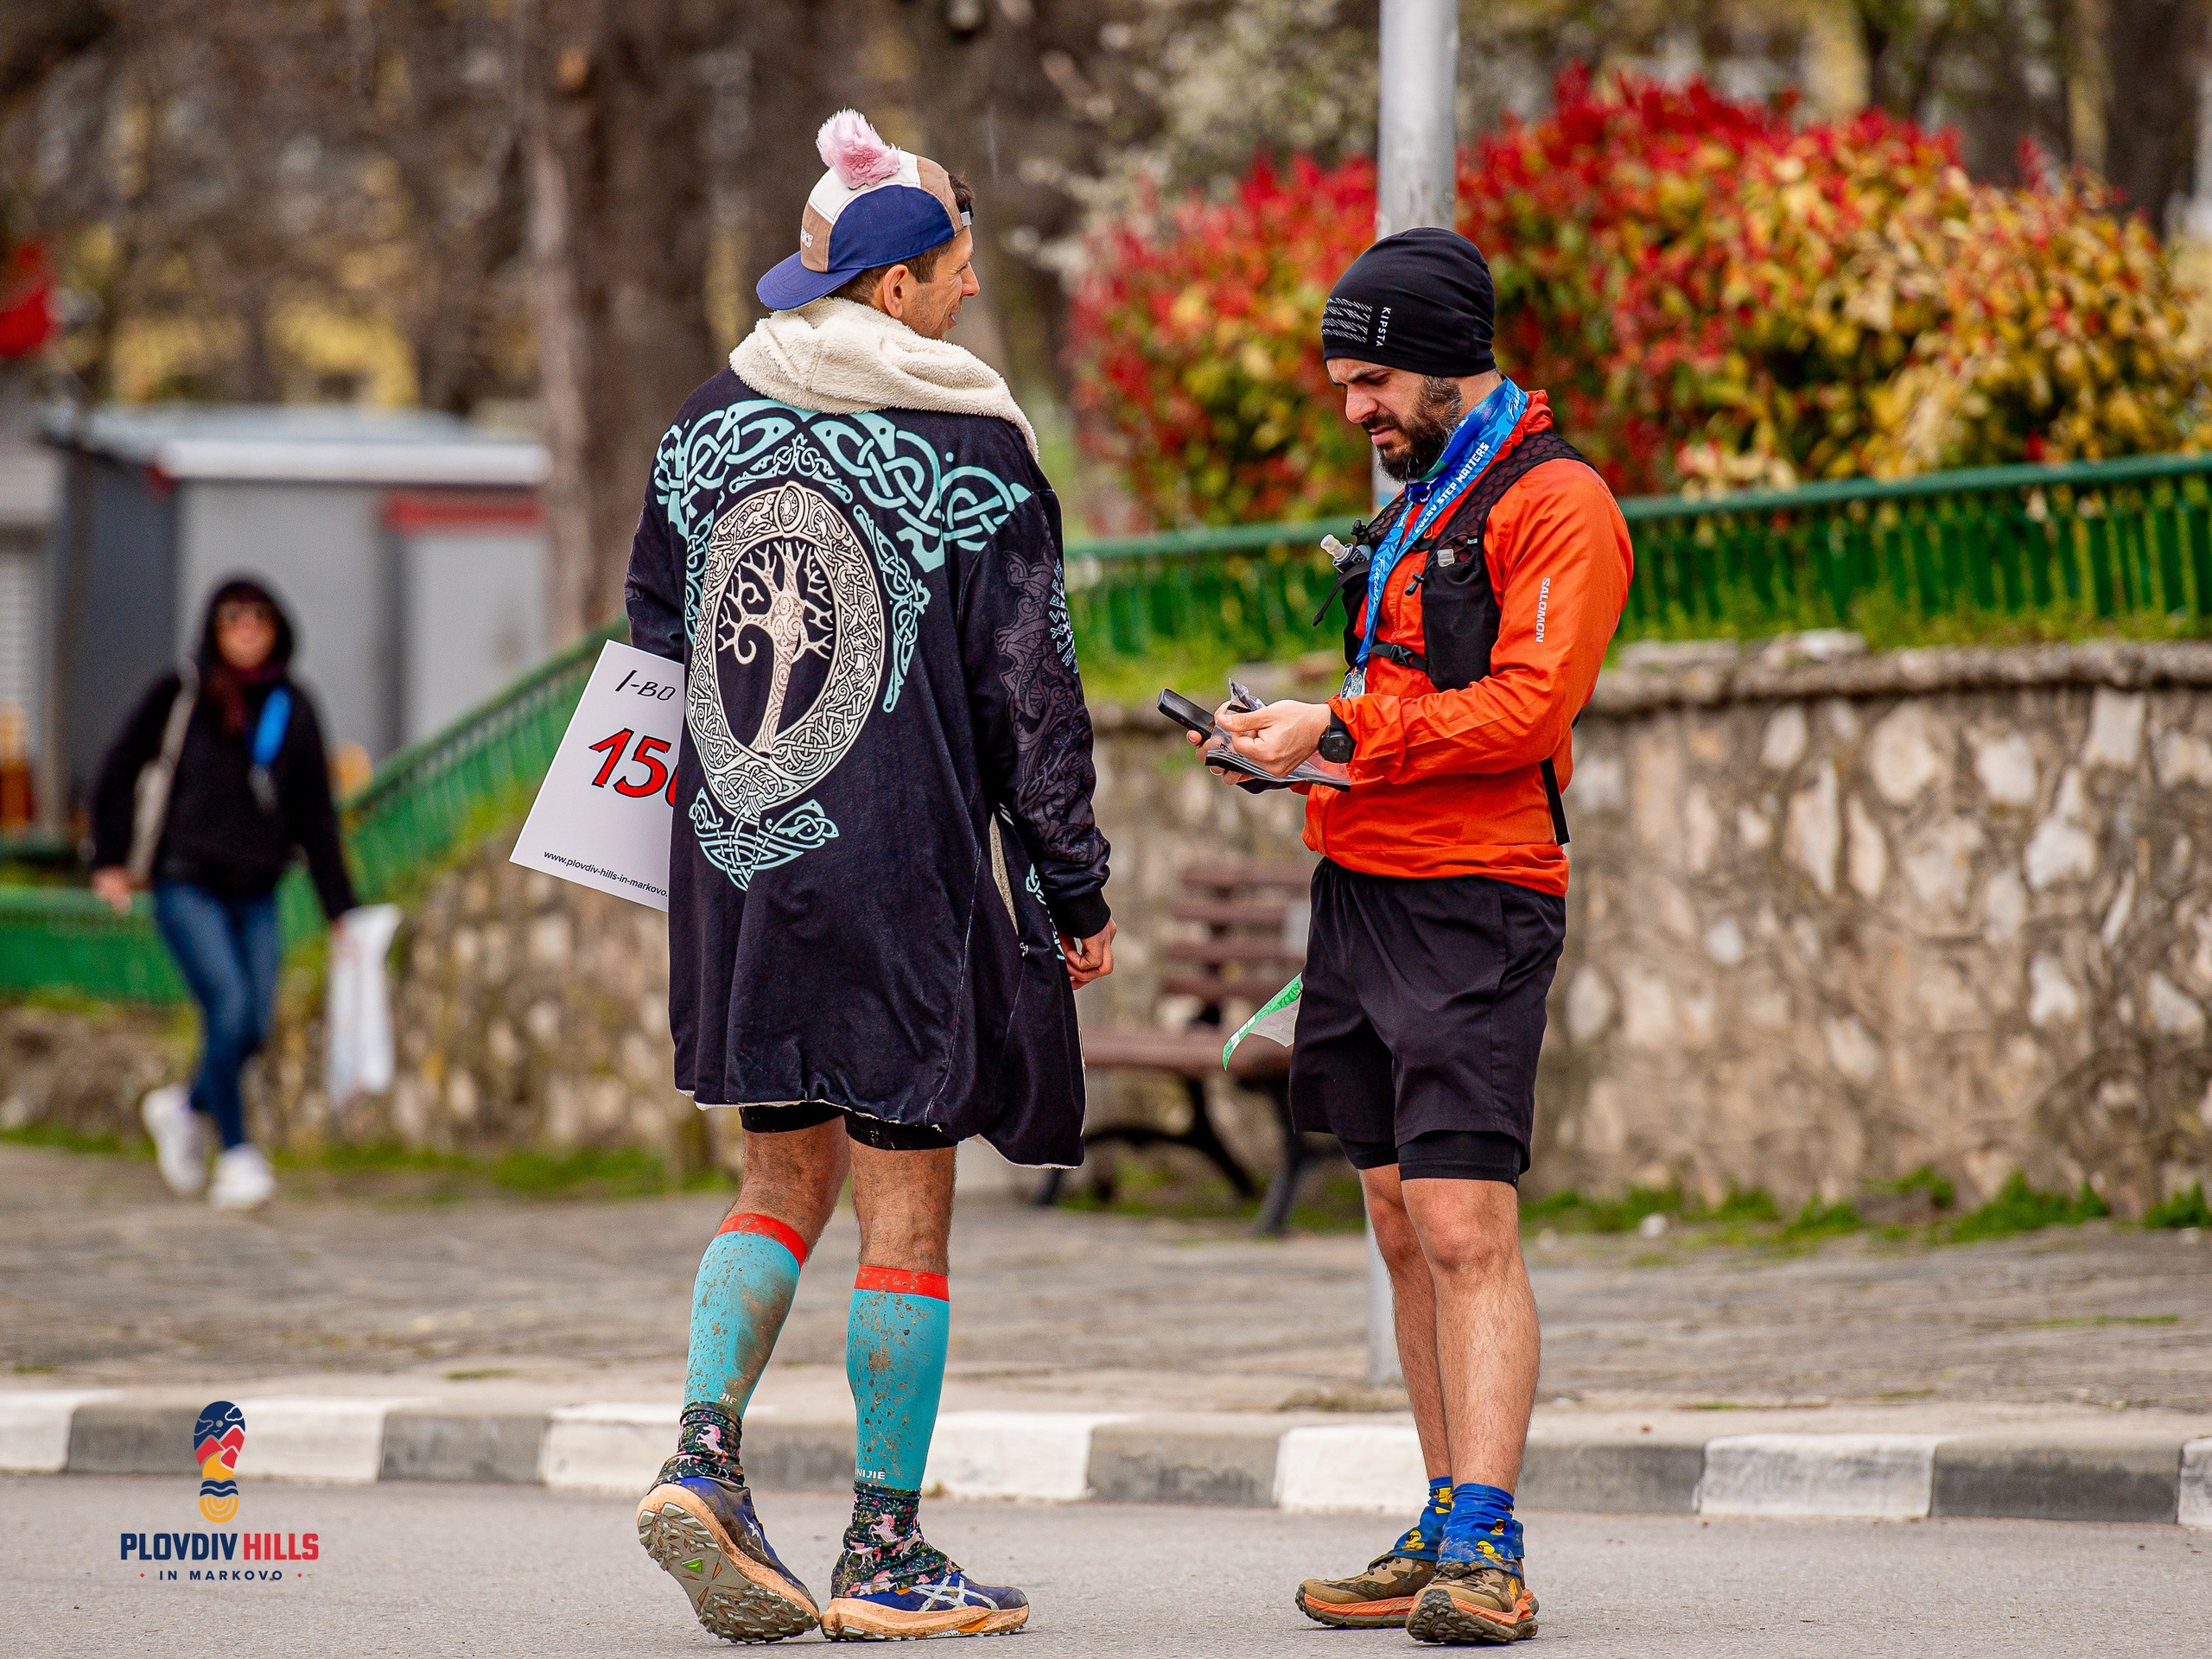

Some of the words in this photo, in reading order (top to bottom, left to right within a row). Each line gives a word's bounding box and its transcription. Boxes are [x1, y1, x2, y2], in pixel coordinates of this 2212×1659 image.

[1376, 306, 1392, 347] KIPSTA
[1435, 482, 1458, 505] STEP
[1455, 442, 1491, 483] MATTERS
[1535, 577, 1551, 643] SALOMON
